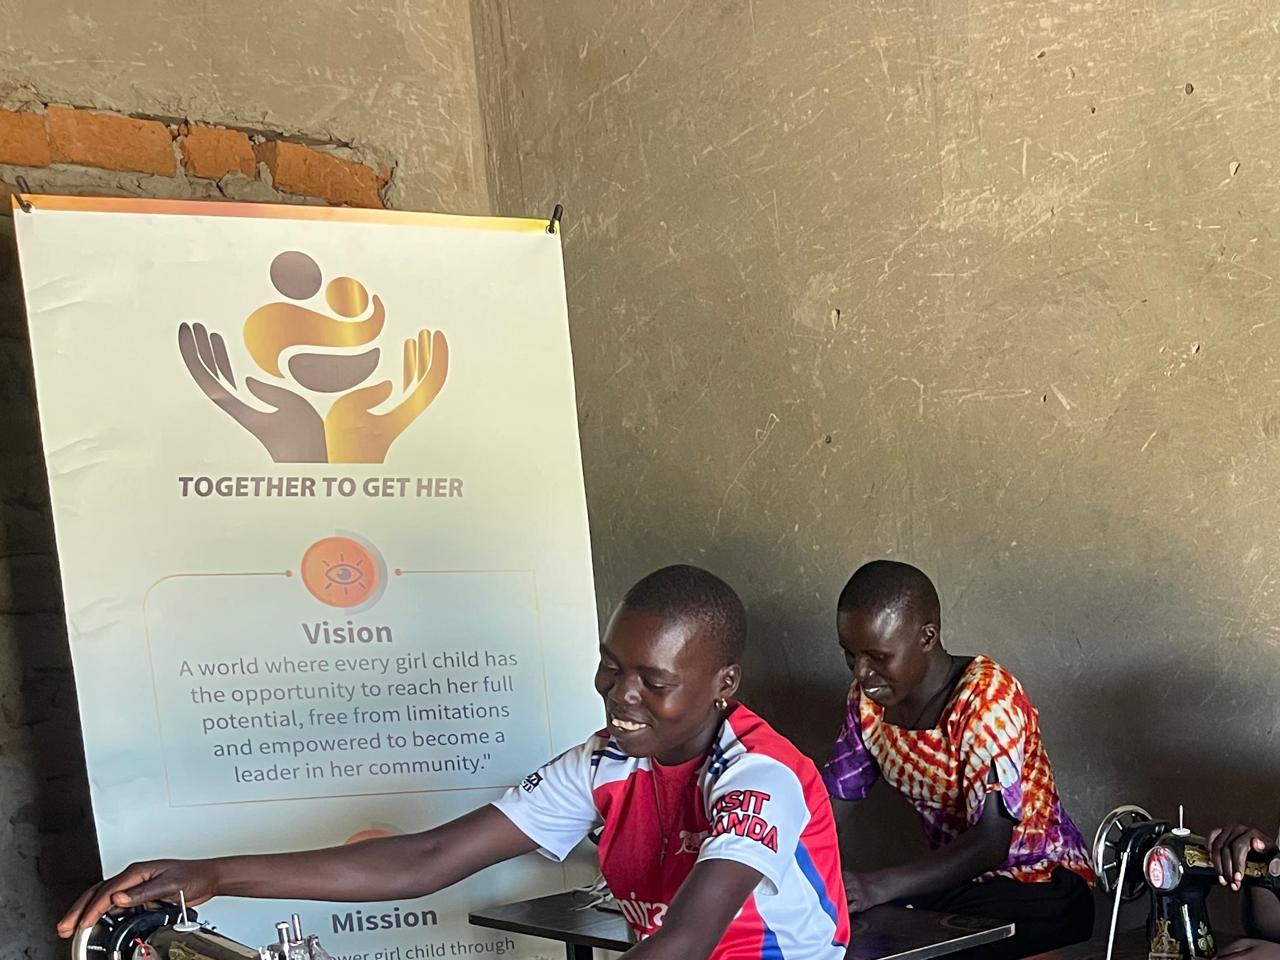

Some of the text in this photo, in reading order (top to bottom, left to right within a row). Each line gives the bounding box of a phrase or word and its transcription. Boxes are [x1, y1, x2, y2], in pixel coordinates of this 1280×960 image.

[179, 476, 464, 498] TOGETHER TO GET HER
[301, 620, 393, 645] Vision
[179, 650, 518, 677] A world where every girl child has
[190, 675, 514, 705] the opportunity to reach her full
[202, 703, 510, 735] potential, free from limitations
[213, 730, 505, 757] and empowered to become a
[234, 753, 491, 783] leader in her community."
[331, 907, 438, 934] Mission
[405, 942, 446, 960] child
[450, 936, 515, 957] through
